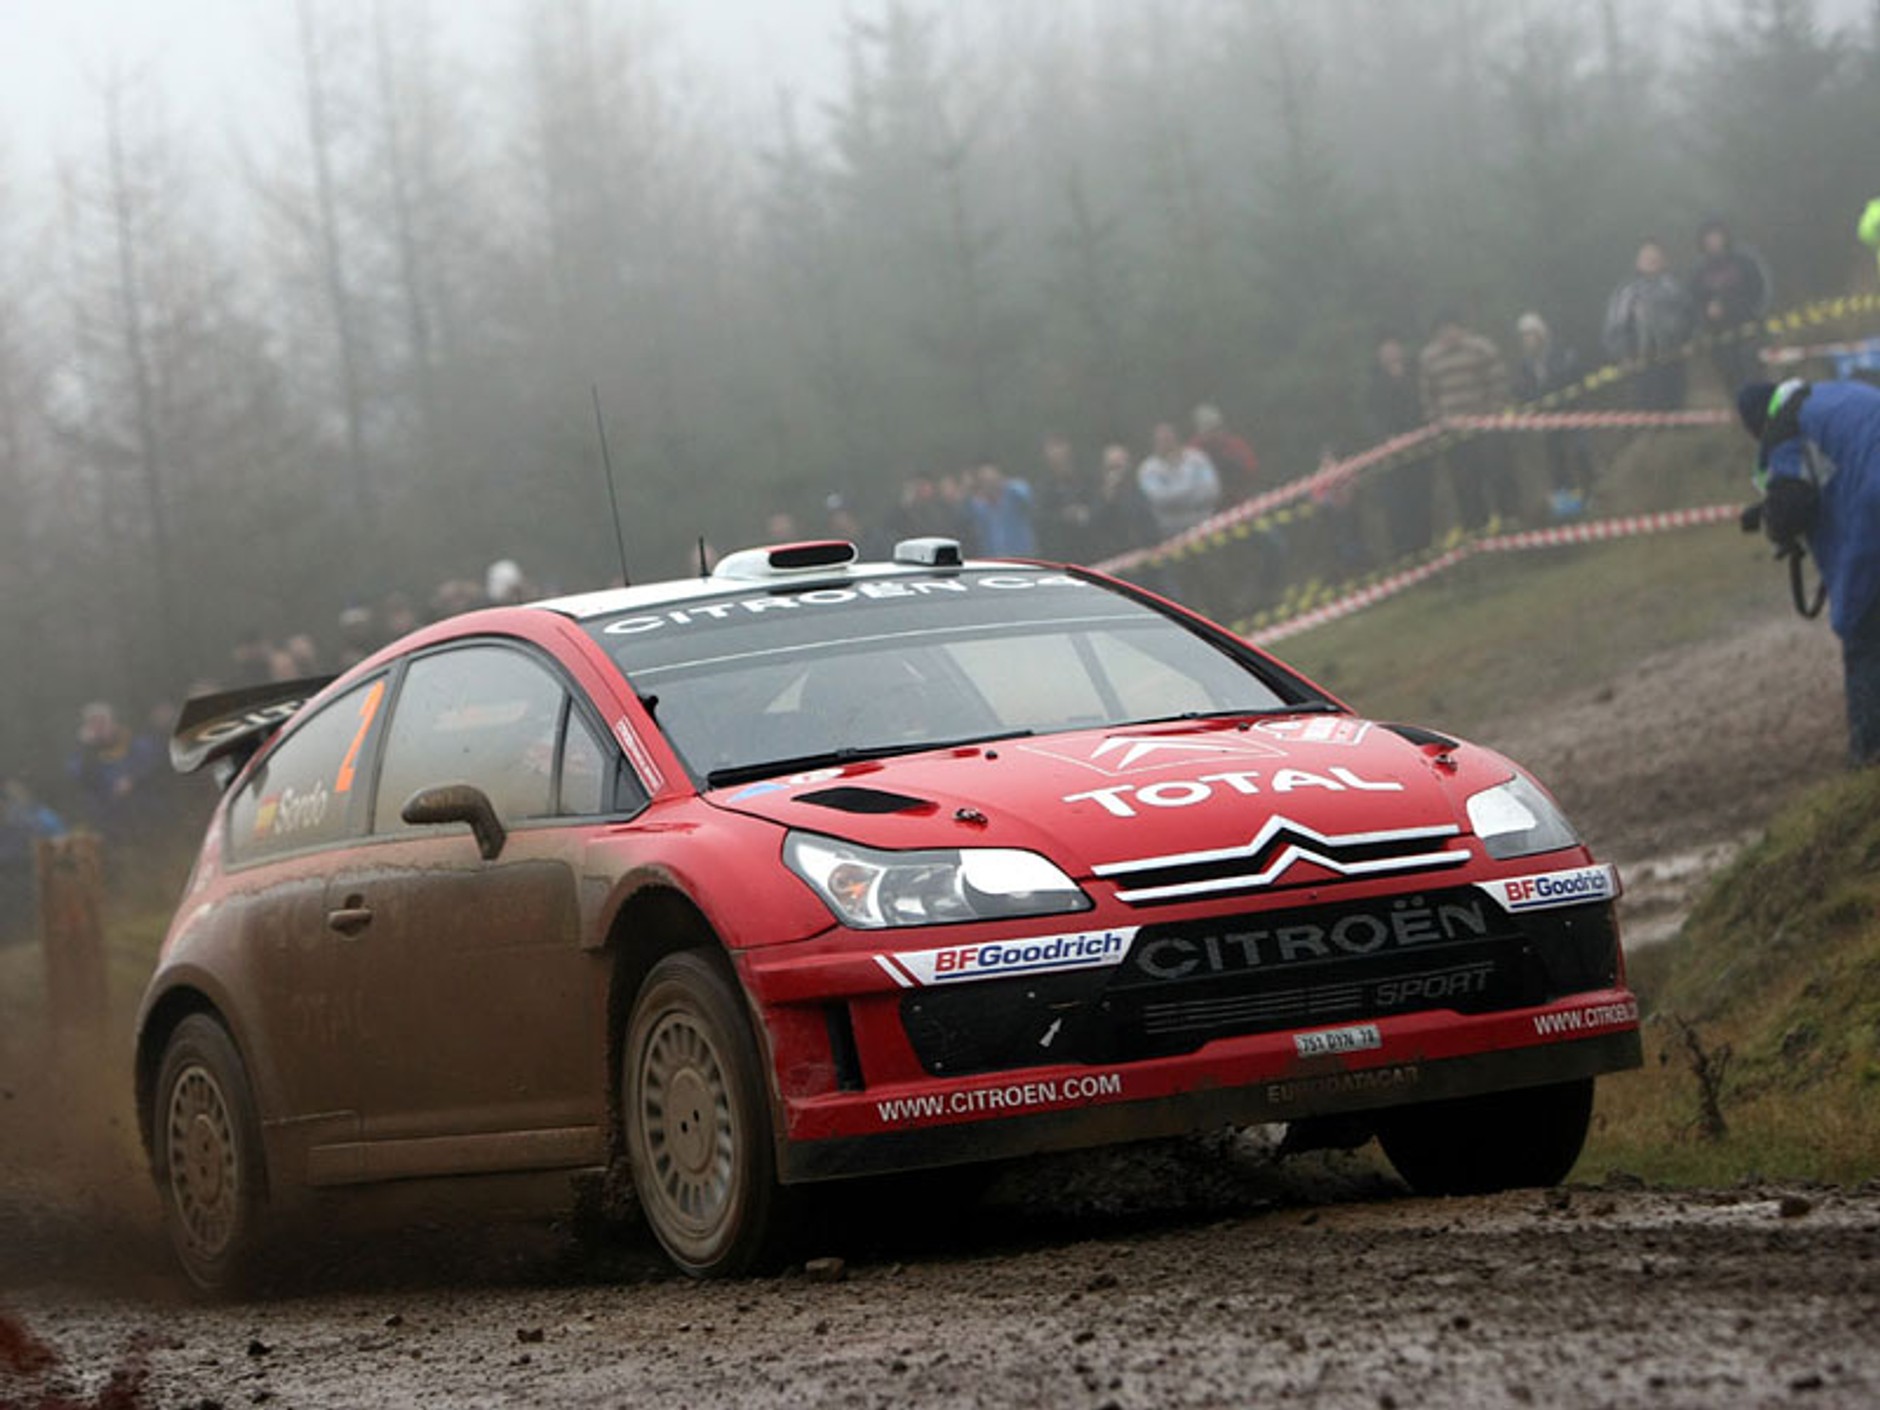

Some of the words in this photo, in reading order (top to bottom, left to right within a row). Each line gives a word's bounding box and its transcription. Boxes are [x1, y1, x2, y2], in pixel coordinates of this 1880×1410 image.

[1062, 767, 1405, 817] TOTAL
[1504, 870, 1608, 902] BFGoodrich
[934, 932, 1122, 973] BFGoodrich
[1136, 897, 1486, 978] CITROËN
[1375, 967, 1493, 1006] SPORT
[878, 1073, 1122, 1122] WWW.CITROEN.COM
